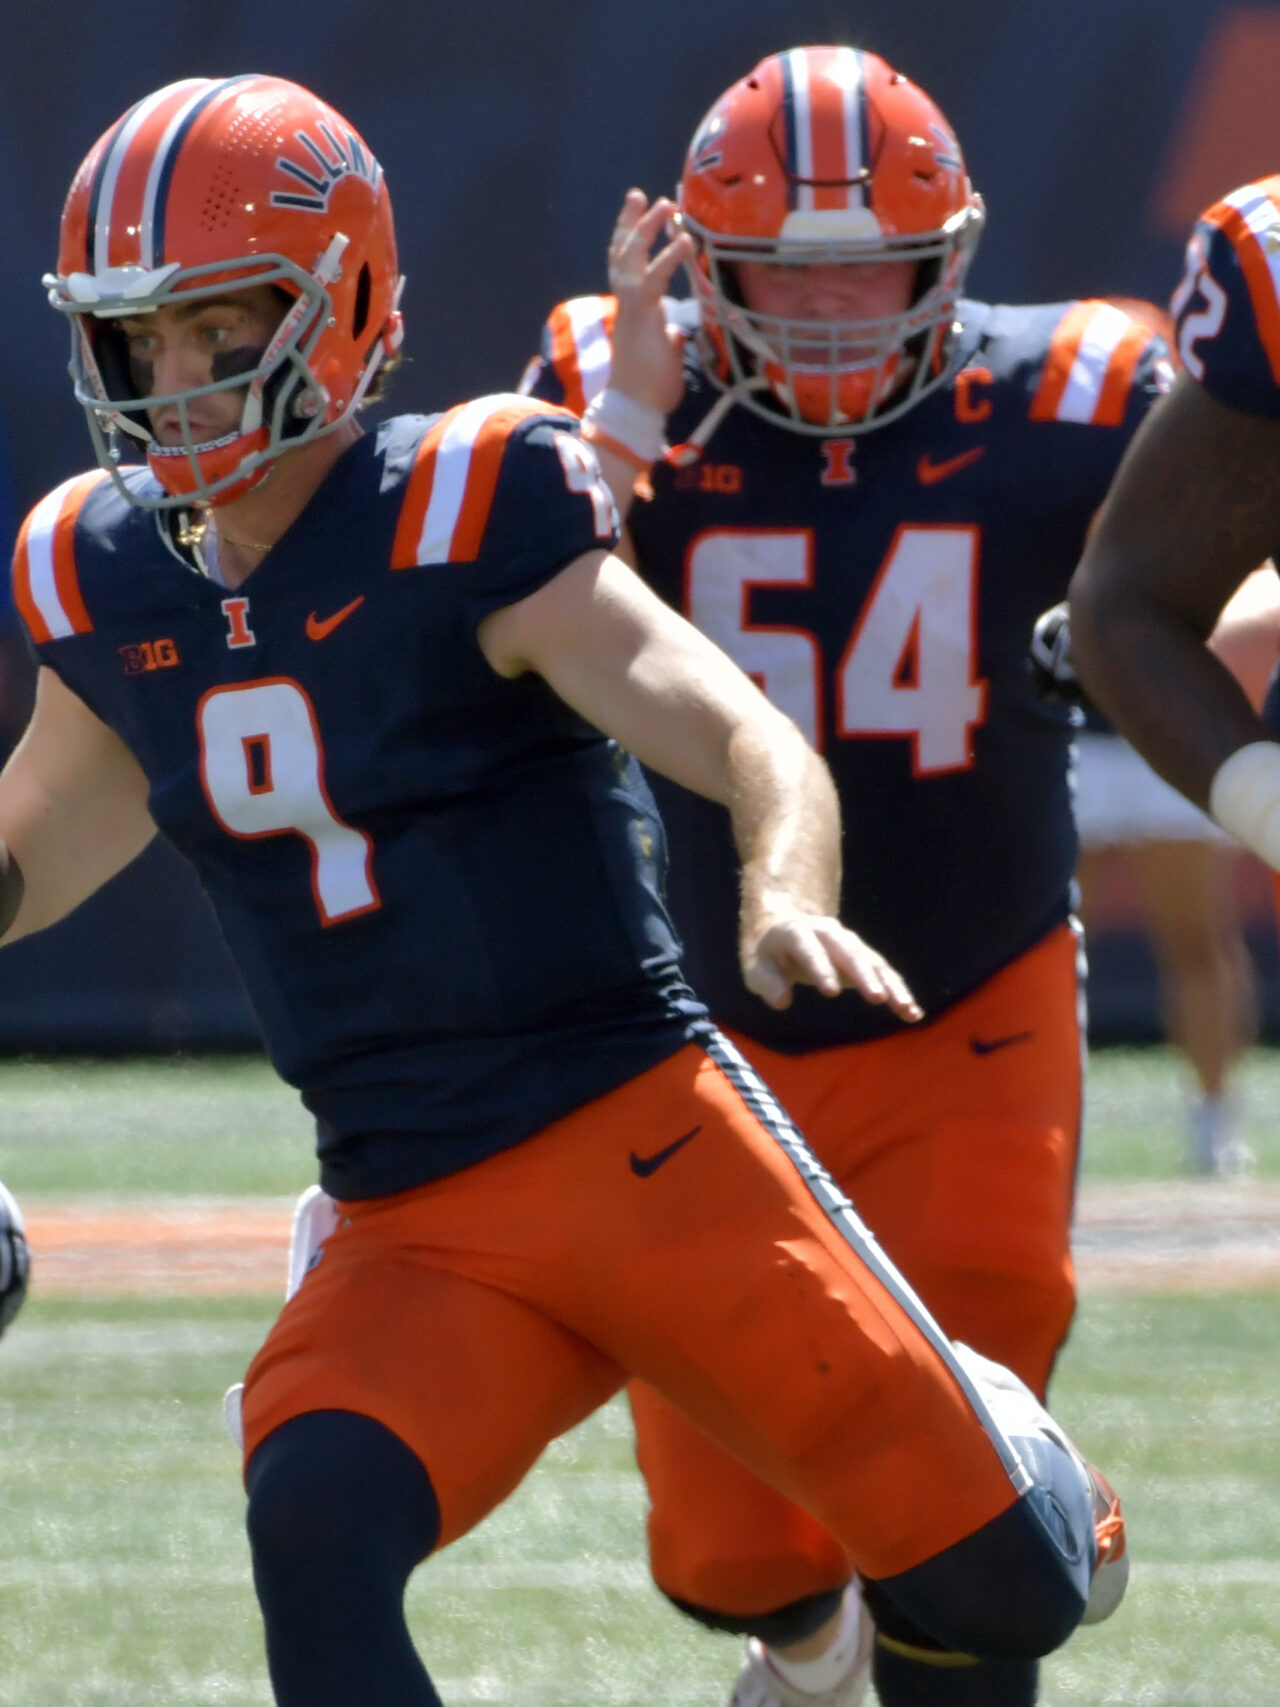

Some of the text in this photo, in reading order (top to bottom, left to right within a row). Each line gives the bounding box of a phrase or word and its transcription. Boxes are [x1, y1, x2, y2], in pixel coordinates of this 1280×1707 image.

[954, 366, 994, 423] C
[821, 438, 857, 486] I
[221, 597, 257, 649] I
[683, 523, 988, 778] 64
[196, 676, 381, 928] 9
